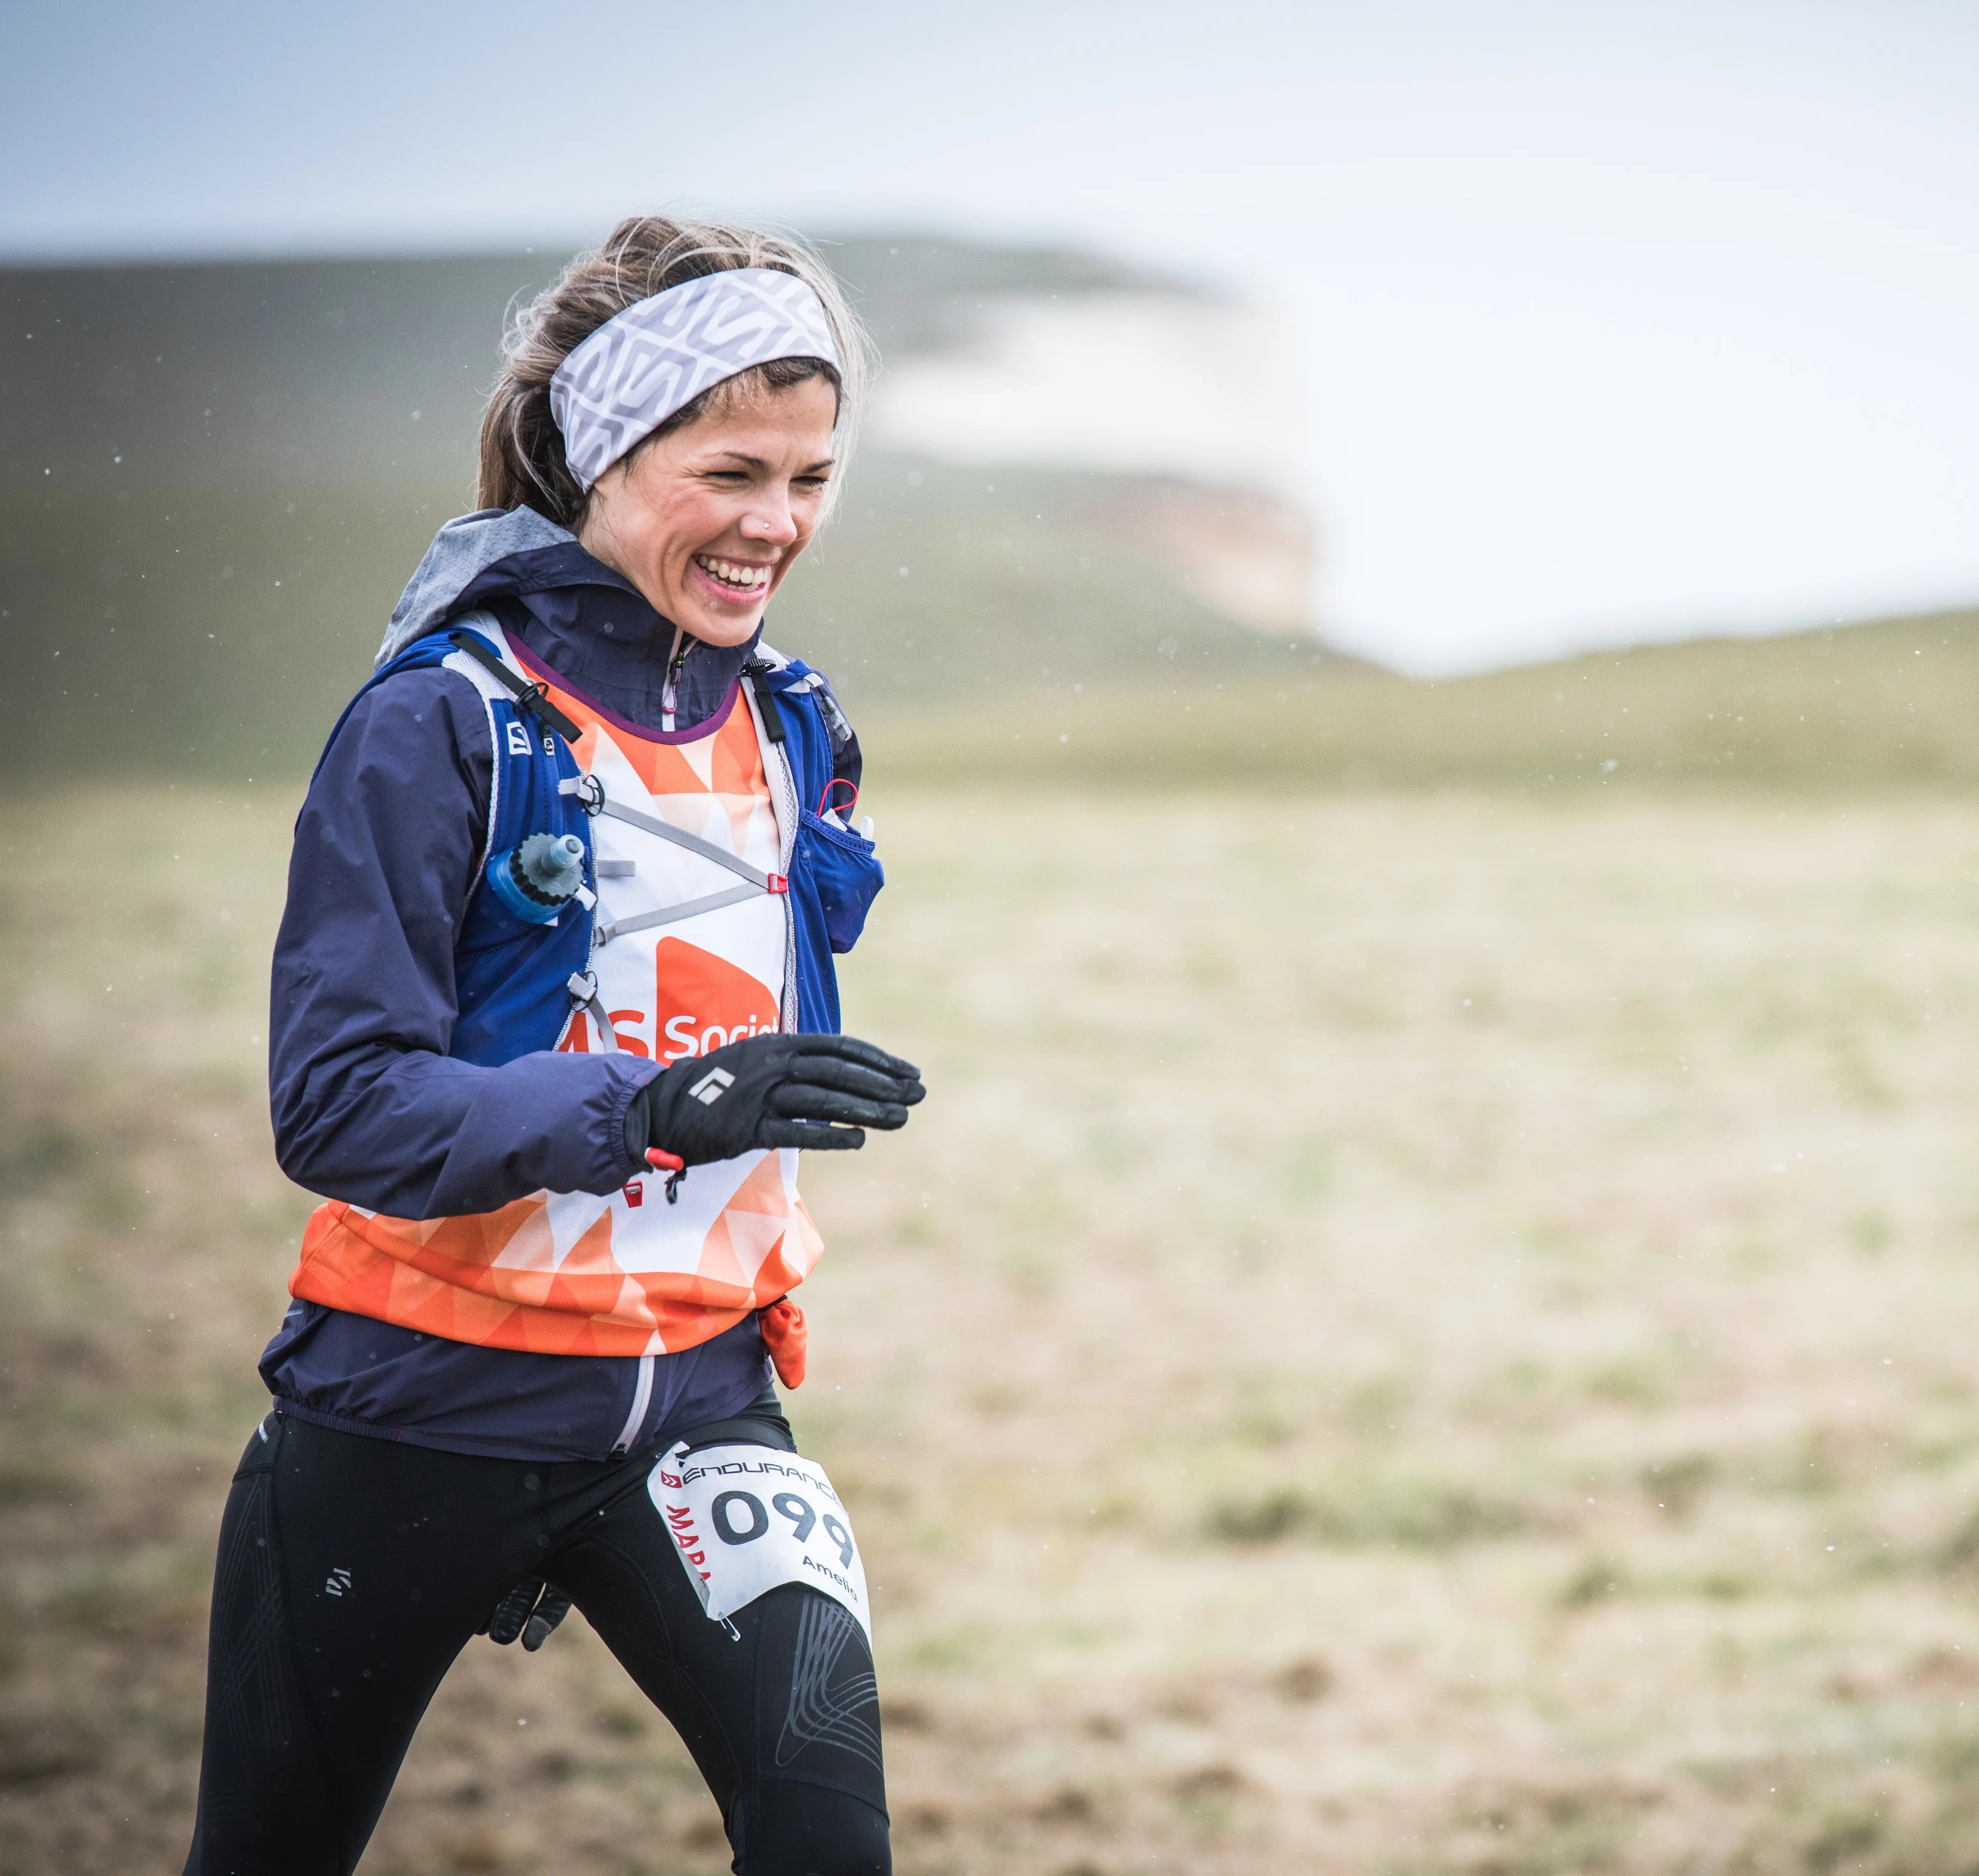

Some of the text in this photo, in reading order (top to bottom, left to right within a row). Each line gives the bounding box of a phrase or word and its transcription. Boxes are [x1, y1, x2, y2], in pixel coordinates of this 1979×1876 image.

[682, 1462, 848, 1518] ENDURANCE
[711, 1490, 853, 1570] 099
[802, 1555, 857, 1603] Amelia
